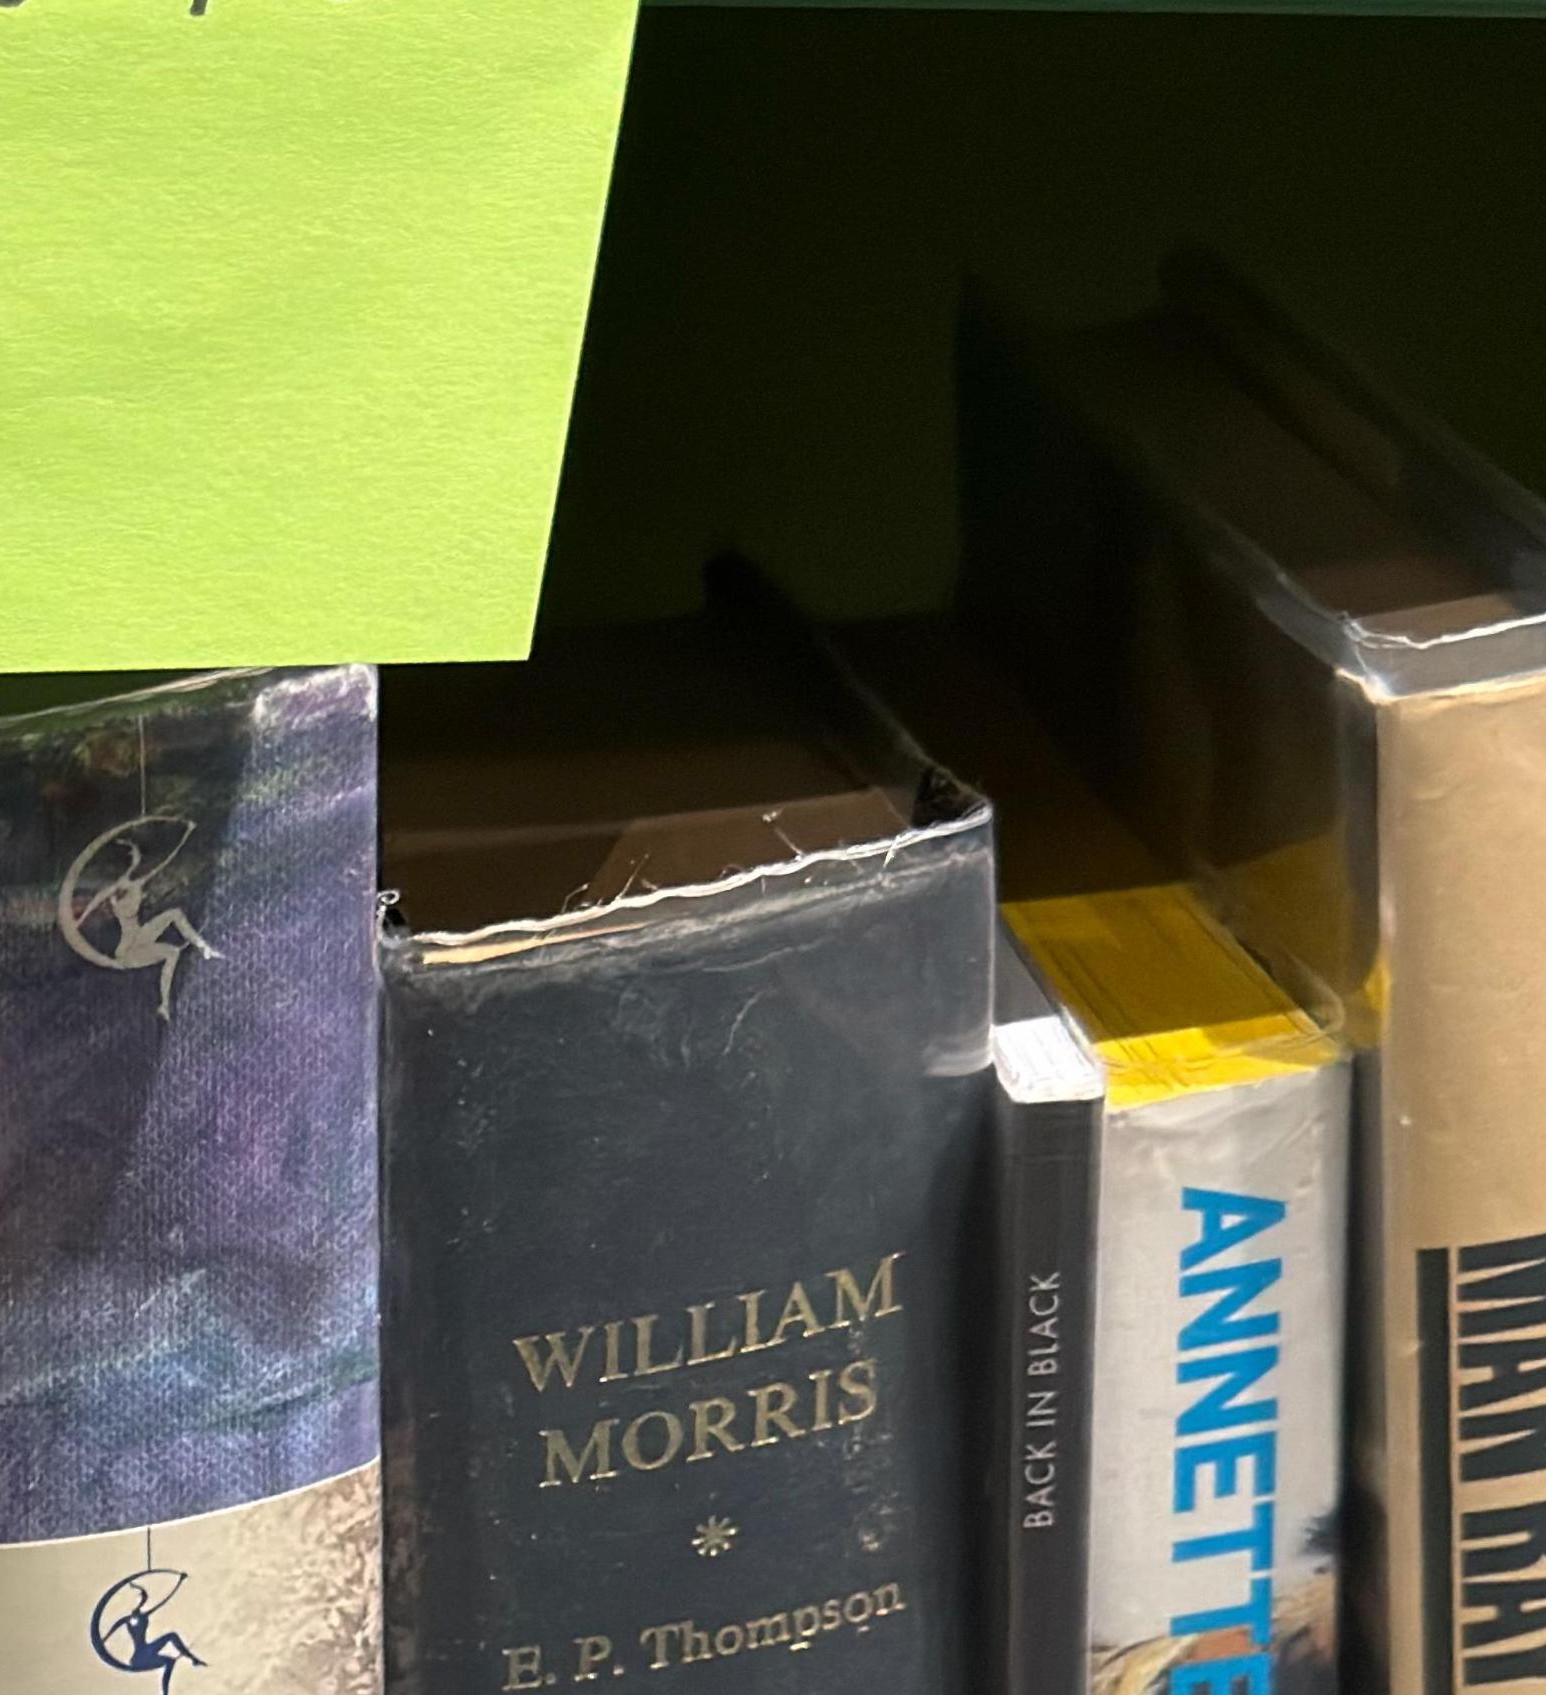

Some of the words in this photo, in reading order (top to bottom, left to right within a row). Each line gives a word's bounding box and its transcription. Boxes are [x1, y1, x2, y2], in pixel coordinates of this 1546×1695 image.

[512, 1250, 906, 1394] WILLIAM
[1027, 1271, 1061, 1376] BLACK
[537, 1356, 879, 1489] MORRIS
[1026, 1391, 1056, 1427] IN
[1023, 1440, 1056, 1528] BACK
[502, 1642, 558, 1692] E.
[573, 1635, 626, 1683] P.
[640, 1580, 909, 1672] Thompson
